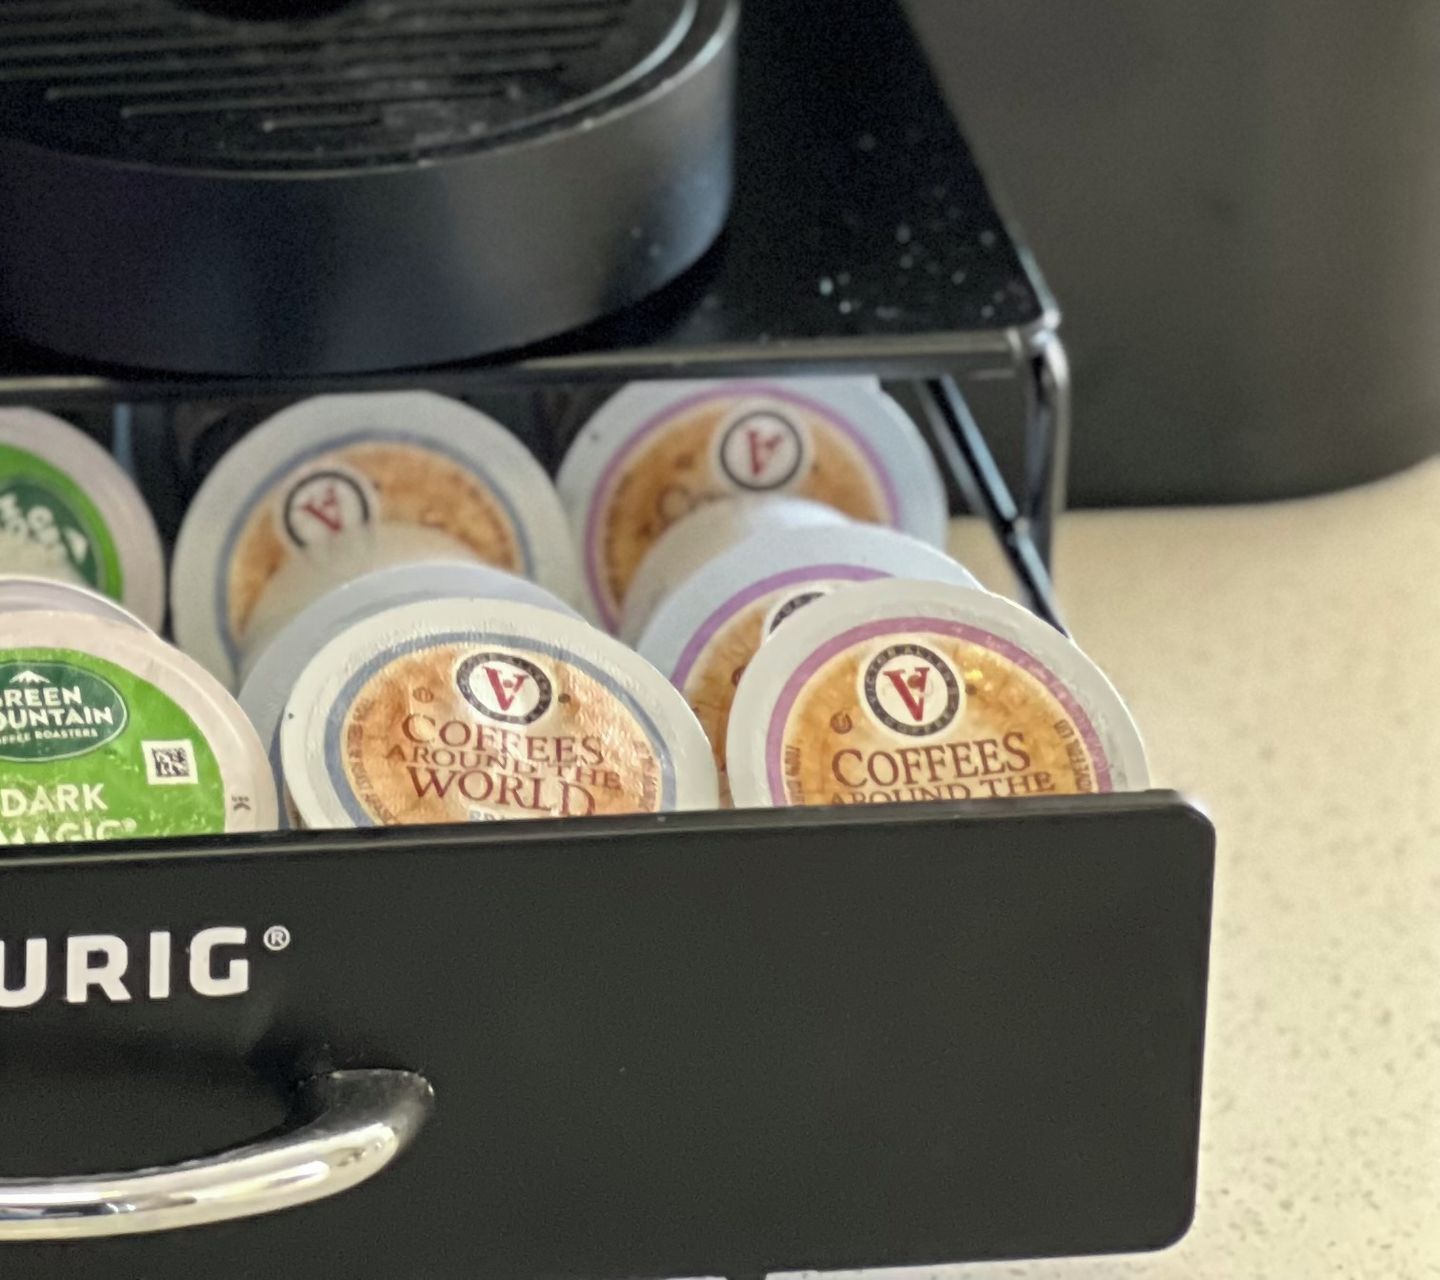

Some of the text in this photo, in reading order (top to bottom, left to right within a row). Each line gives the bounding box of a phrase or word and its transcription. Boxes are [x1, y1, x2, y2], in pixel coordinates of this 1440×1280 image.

[35, 728, 98, 740] ROASTERS
[402, 713, 605, 766] COFFEES
[385, 744, 536, 776] AROUND
[832, 732, 1031, 788] COFFEES
[0, 783, 108, 817] DARK
[406, 766, 596, 816] WORLD
[980, 771, 1056, 799] THE
